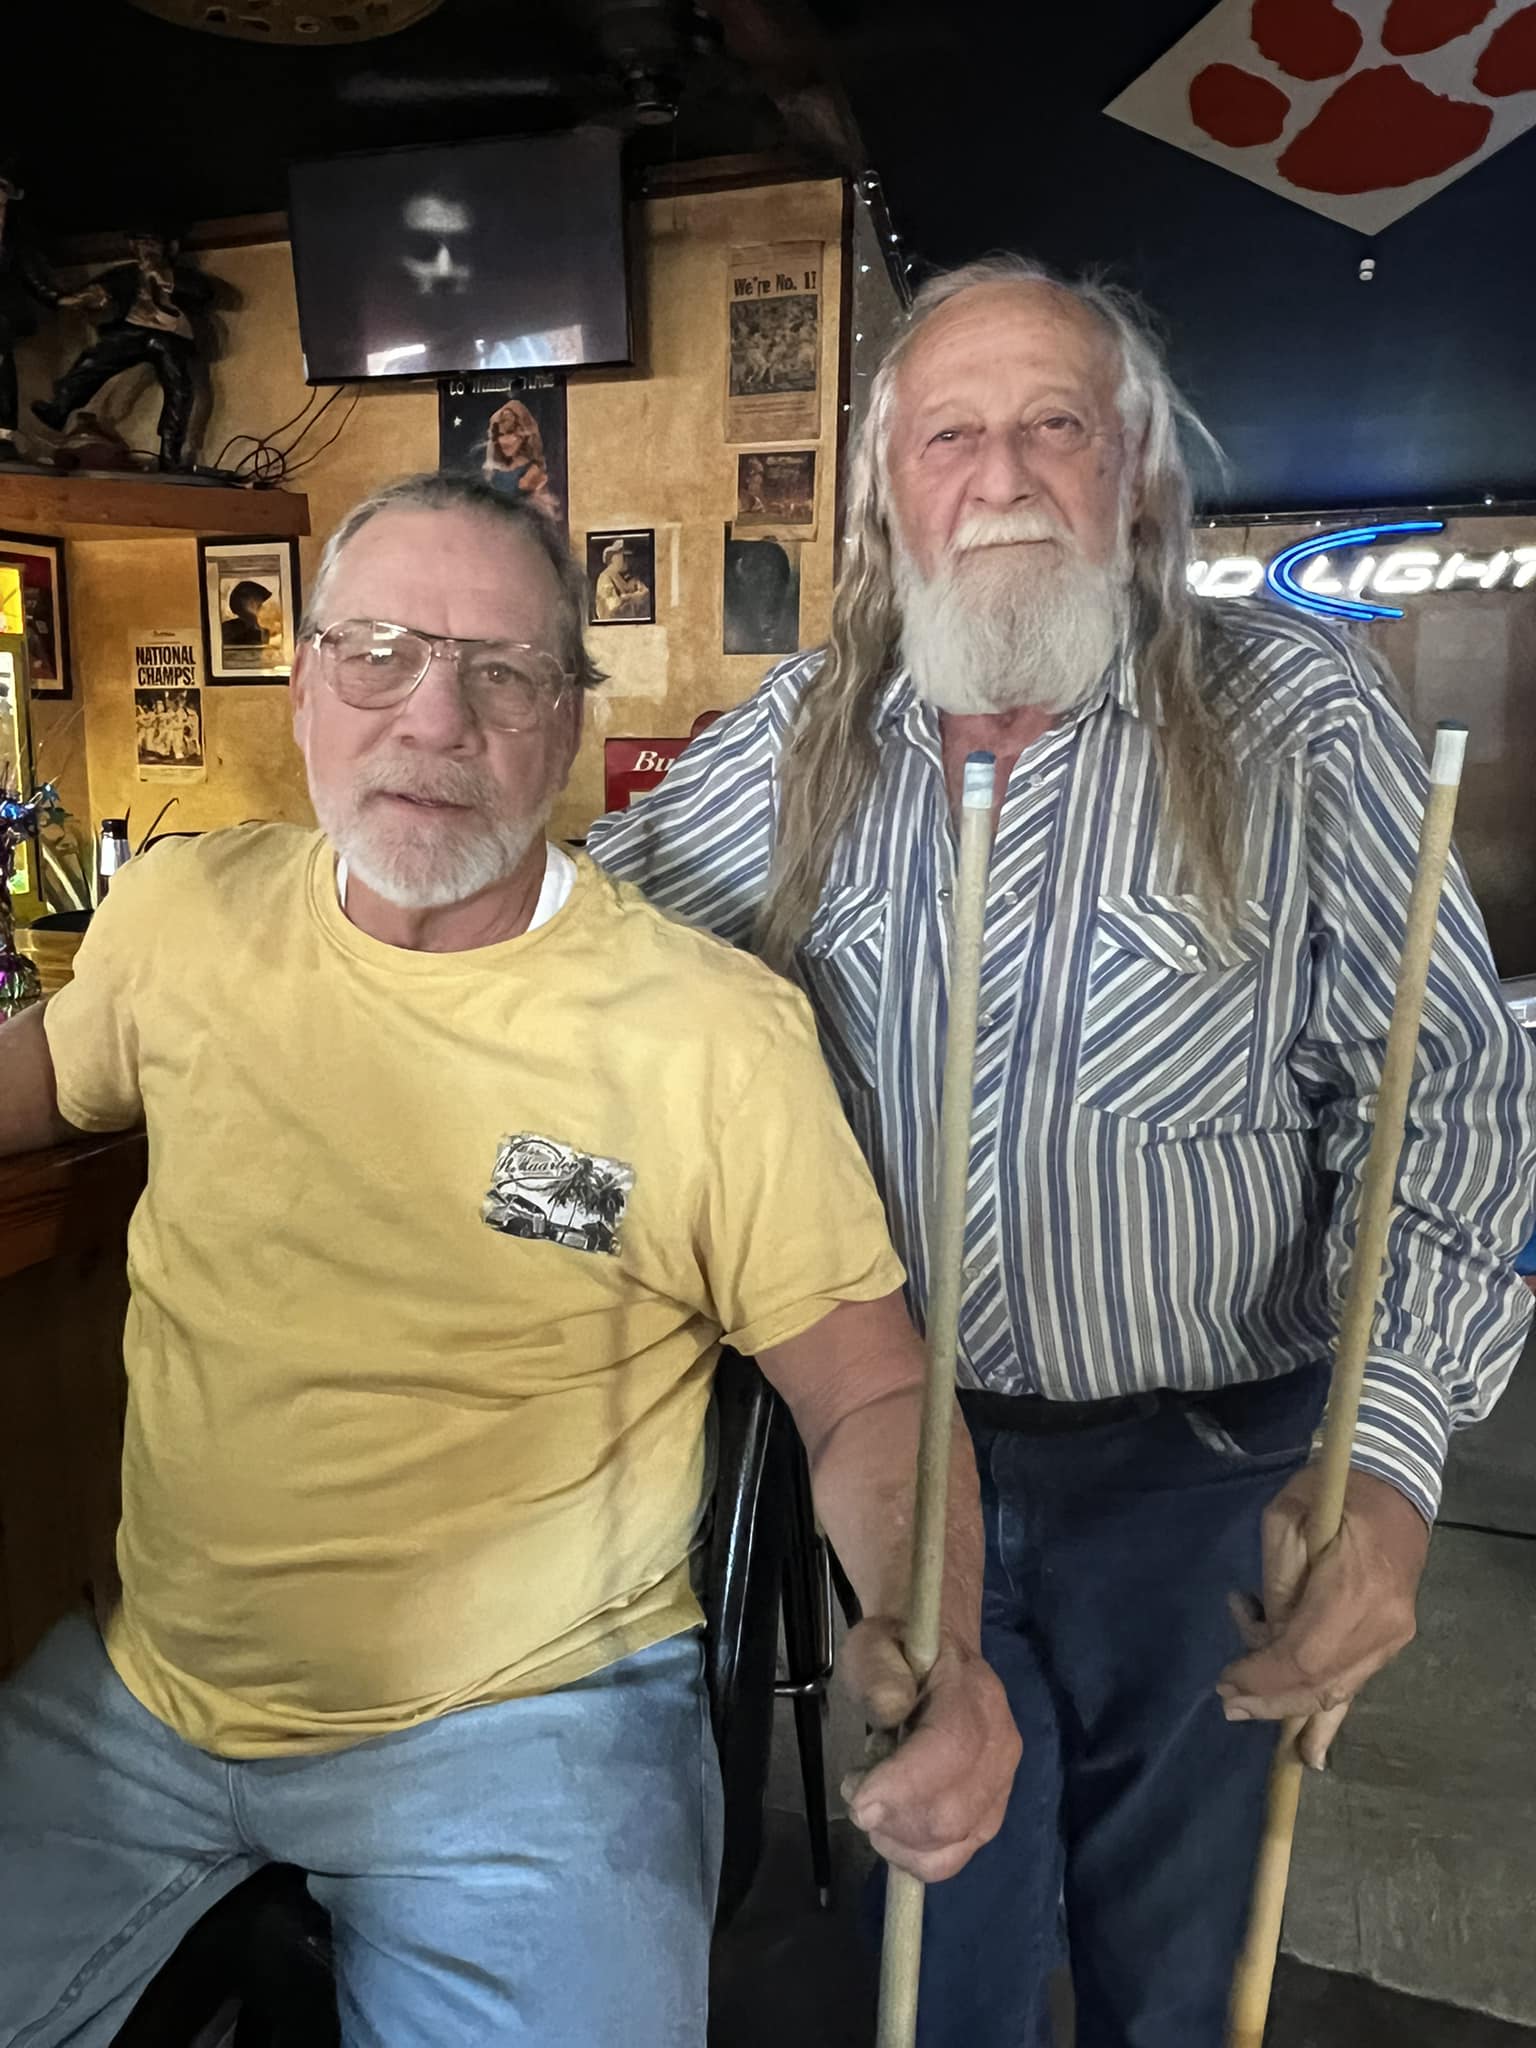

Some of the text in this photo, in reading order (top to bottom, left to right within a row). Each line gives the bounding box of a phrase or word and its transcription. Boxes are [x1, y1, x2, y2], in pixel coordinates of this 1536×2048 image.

[734, 277, 770, 297] We're
[776, 273, 797, 292] No.
[135, 646, 196, 666] NATIONAL
[137, 666, 195, 686] CHAMPS!
